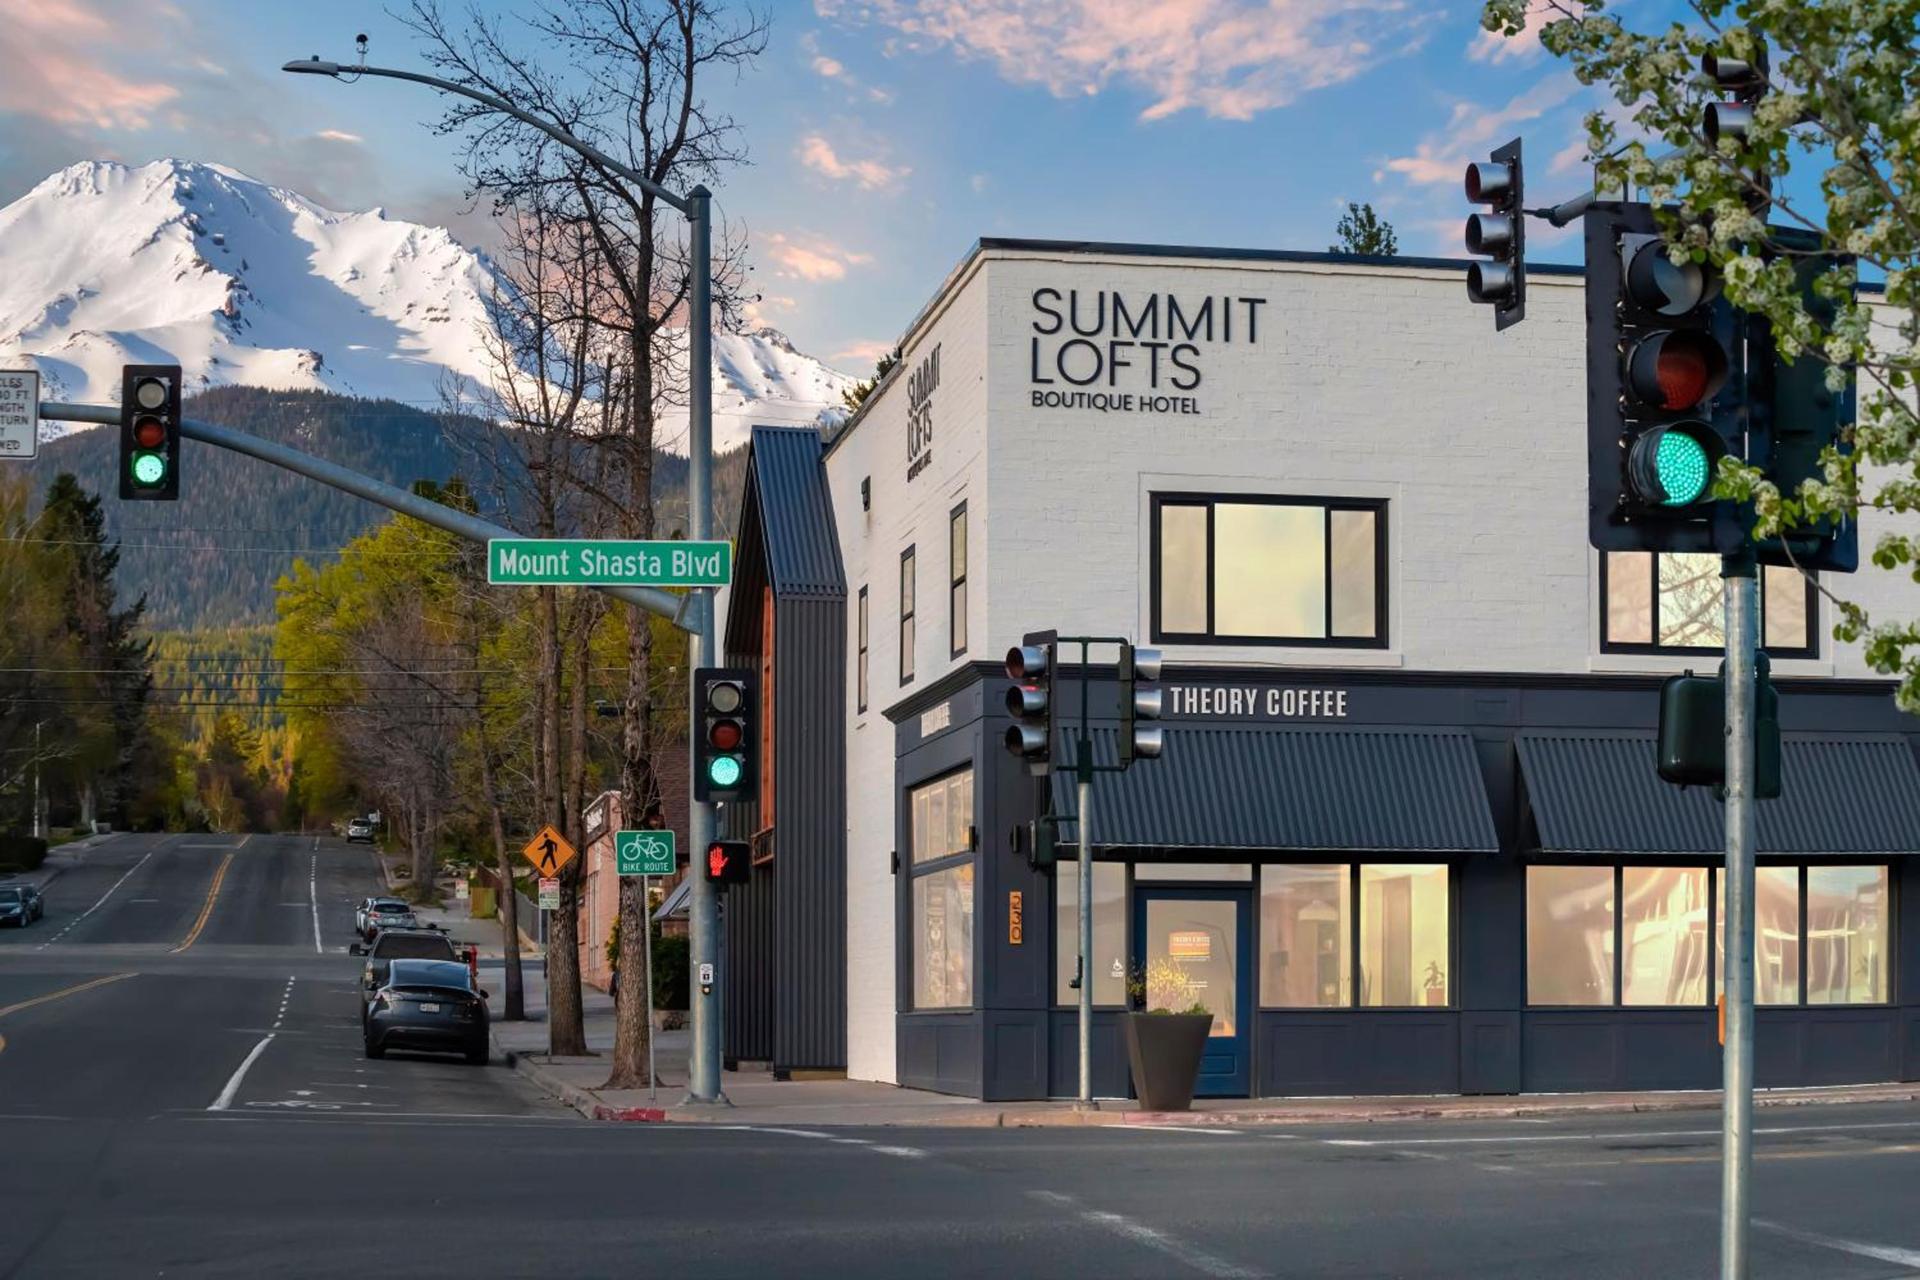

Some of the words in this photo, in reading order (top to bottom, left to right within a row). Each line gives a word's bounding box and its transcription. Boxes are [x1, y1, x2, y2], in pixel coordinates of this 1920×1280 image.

[1032, 287, 1267, 344] SUMMIT
[1032, 337, 1201, 391] LOFTS
[1032, 390, 1133, 413] BOUTIQUE
[1139, 396, 1201, 415] HOTEL
[500, 548, 570, 576] Mount
[580, 549, 661, 577] Shasta
[672, 550, 721, 577] Blvd
[1170, 687, 1258, 715] THEORY
[1266, 688, 1347, 717] COFFEE
[622, 862, 641, 872] BIKE
[644, 862, 669, 872] ROUTE
[1011, 895, 1021, 941] 230
